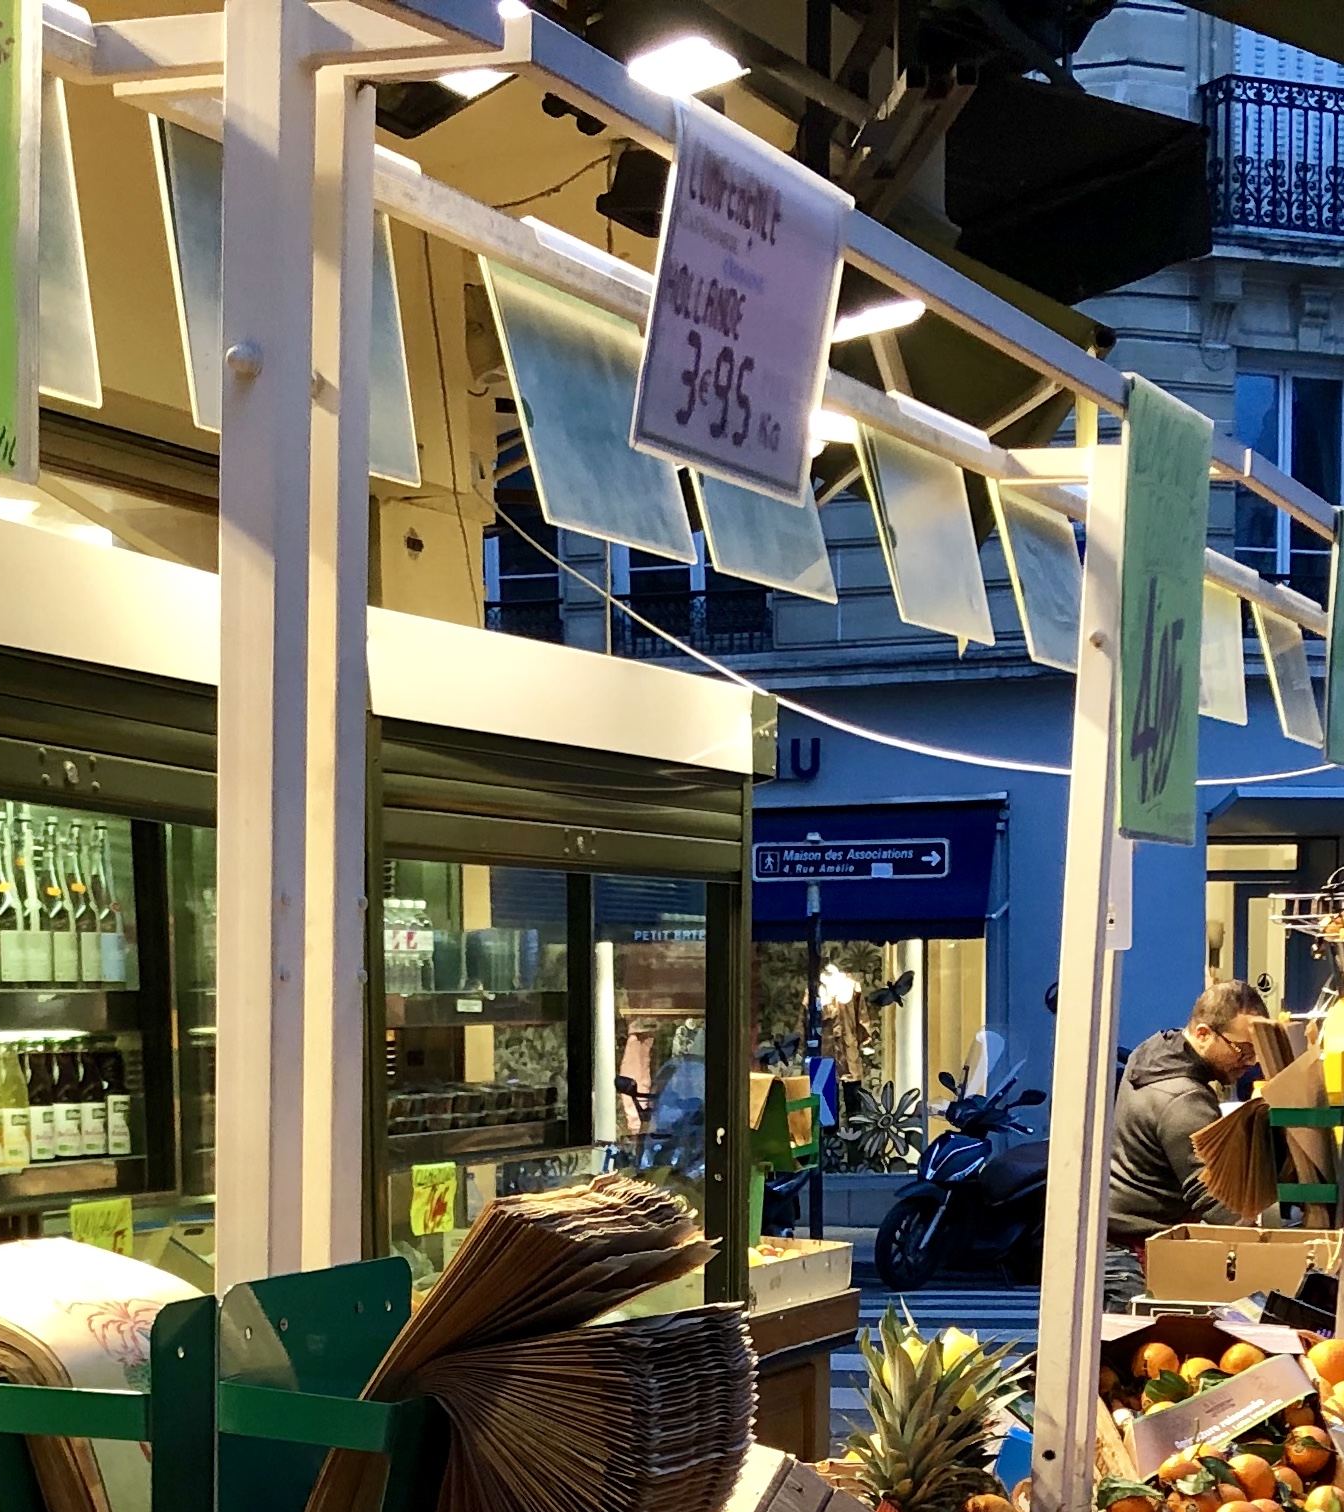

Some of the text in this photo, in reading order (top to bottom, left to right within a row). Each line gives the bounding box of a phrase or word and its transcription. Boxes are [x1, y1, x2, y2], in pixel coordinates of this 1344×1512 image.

[782, 847, 914, 861] Maison des Associations
[795, 863, 815, 874] Rue
[633, 930, 669, 941] PETIT
